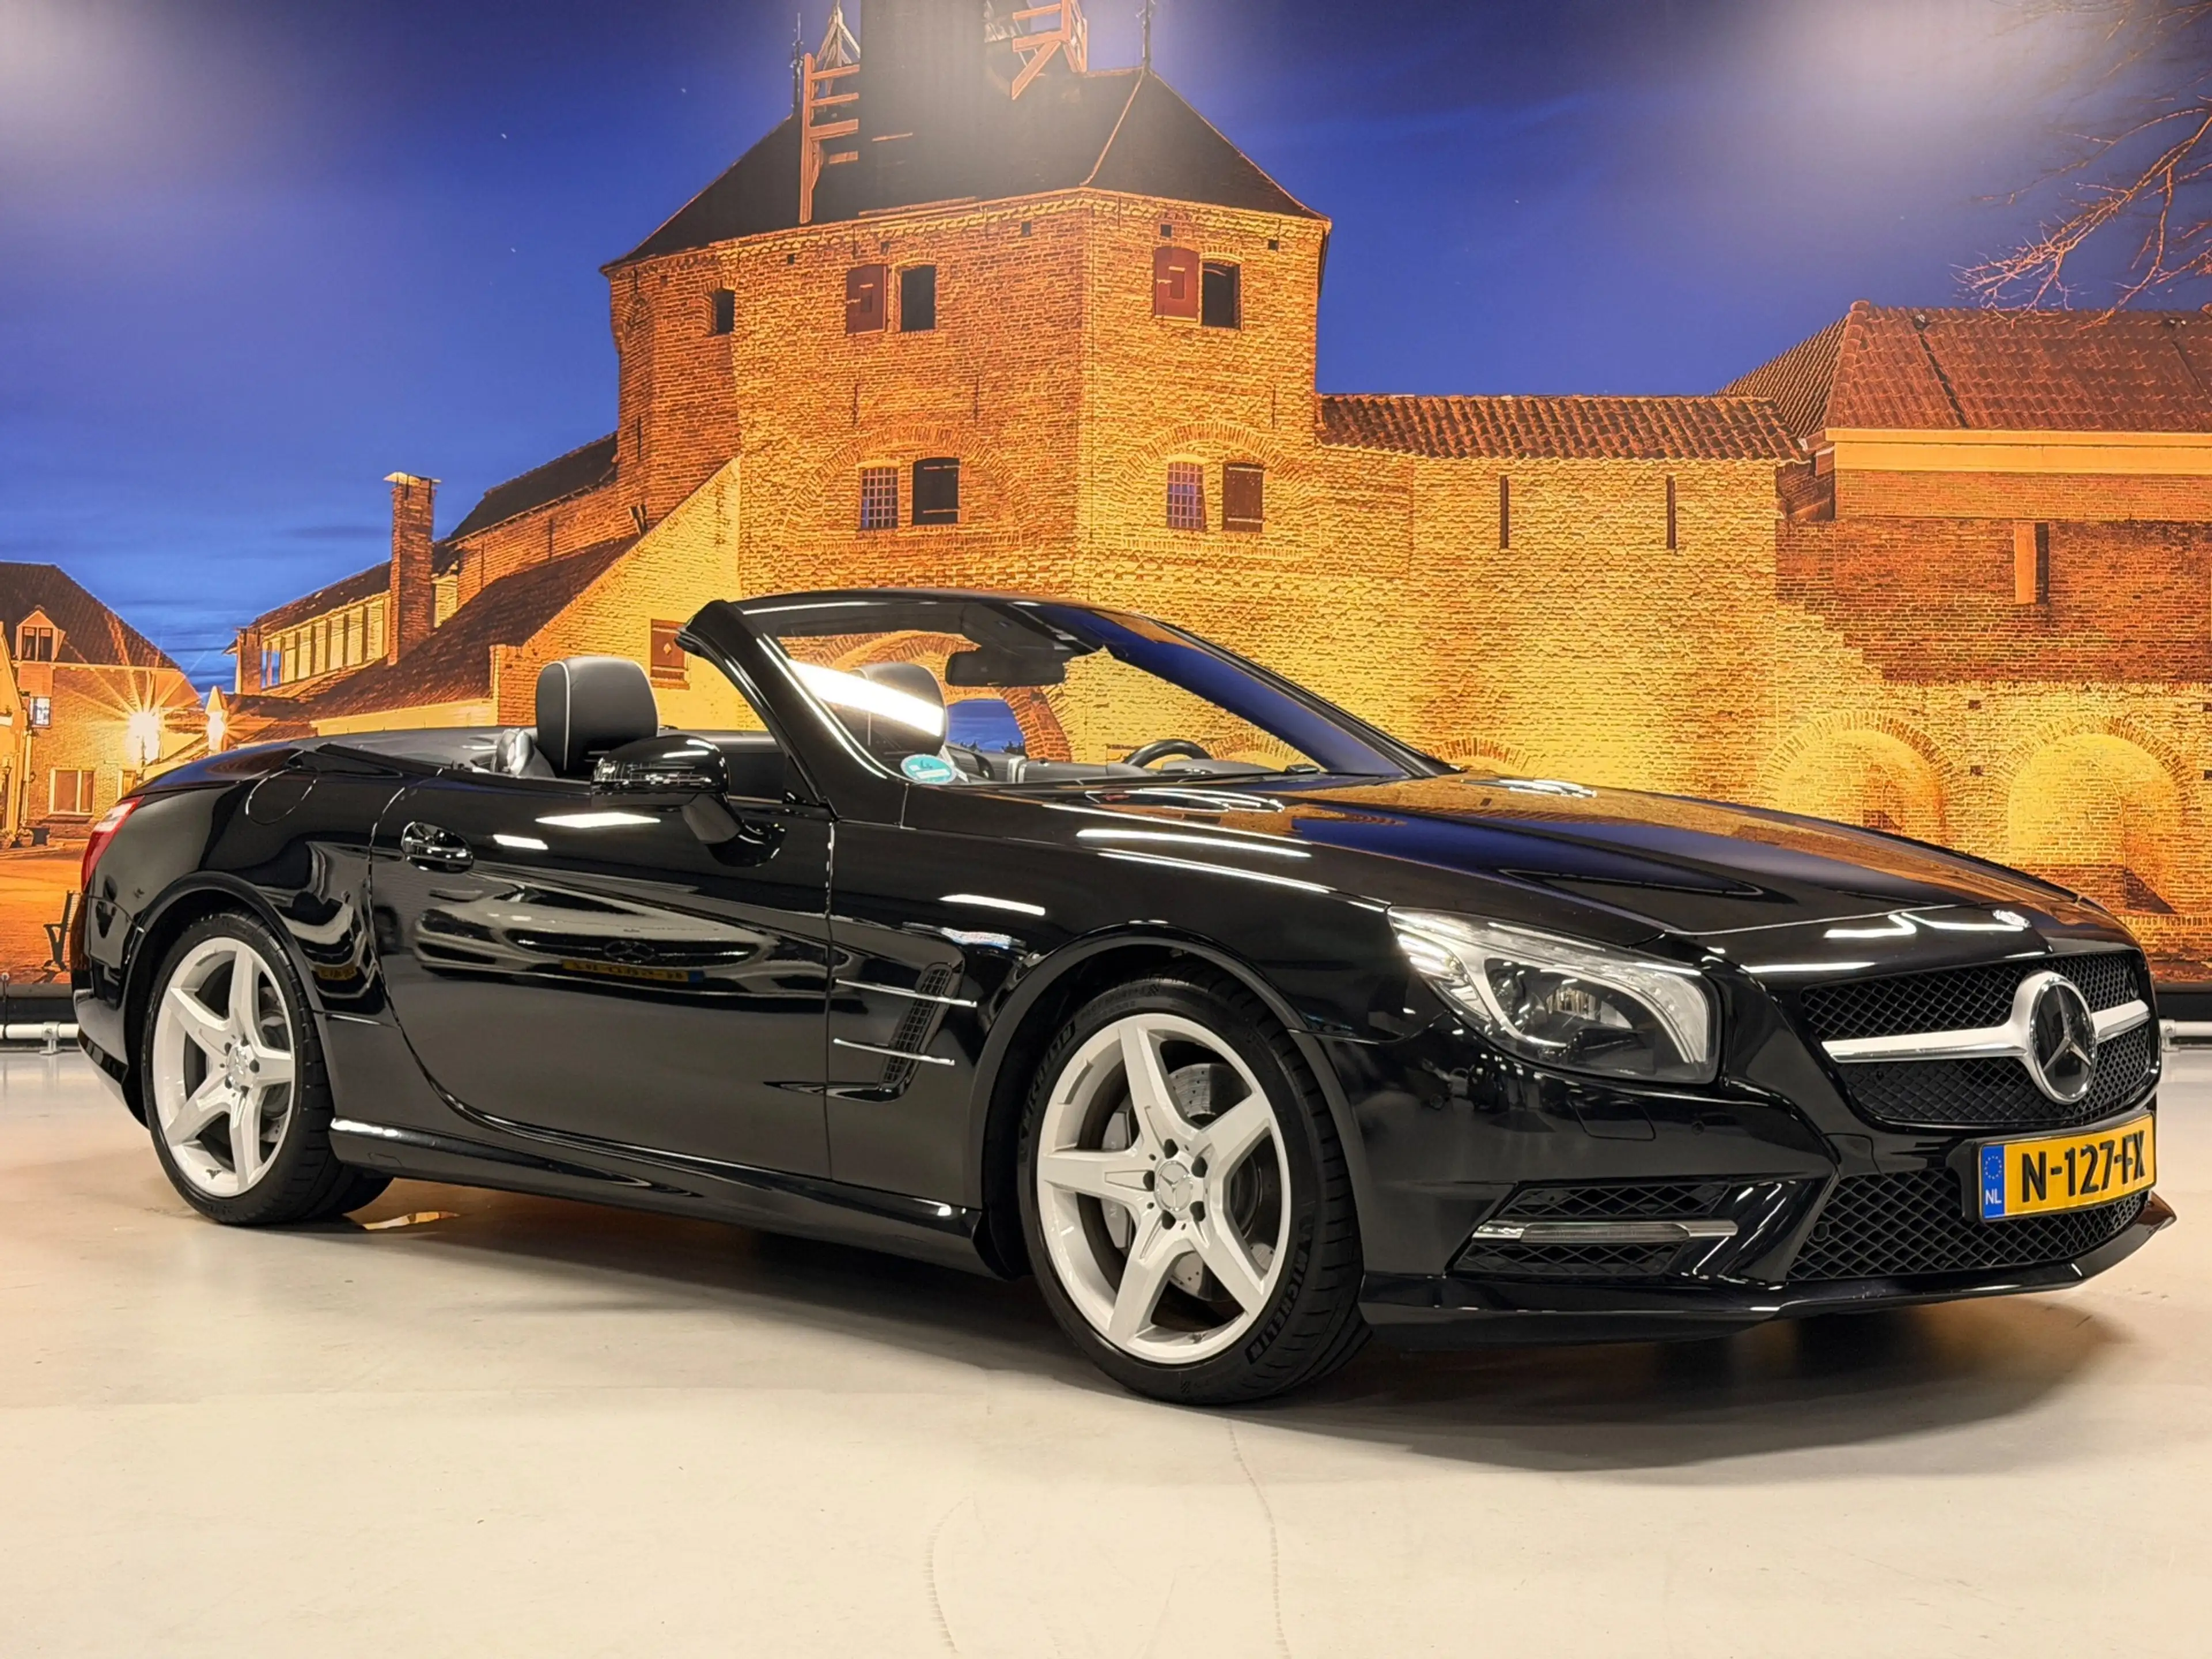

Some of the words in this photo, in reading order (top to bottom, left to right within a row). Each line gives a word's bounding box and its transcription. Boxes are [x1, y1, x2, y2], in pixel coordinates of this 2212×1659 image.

[1985, 1188, 2002, 1205] NL
[2022, 1130, 2146, 1203] N-127-FX
[1249, 1248, 1309, 1359] MICHELIN
